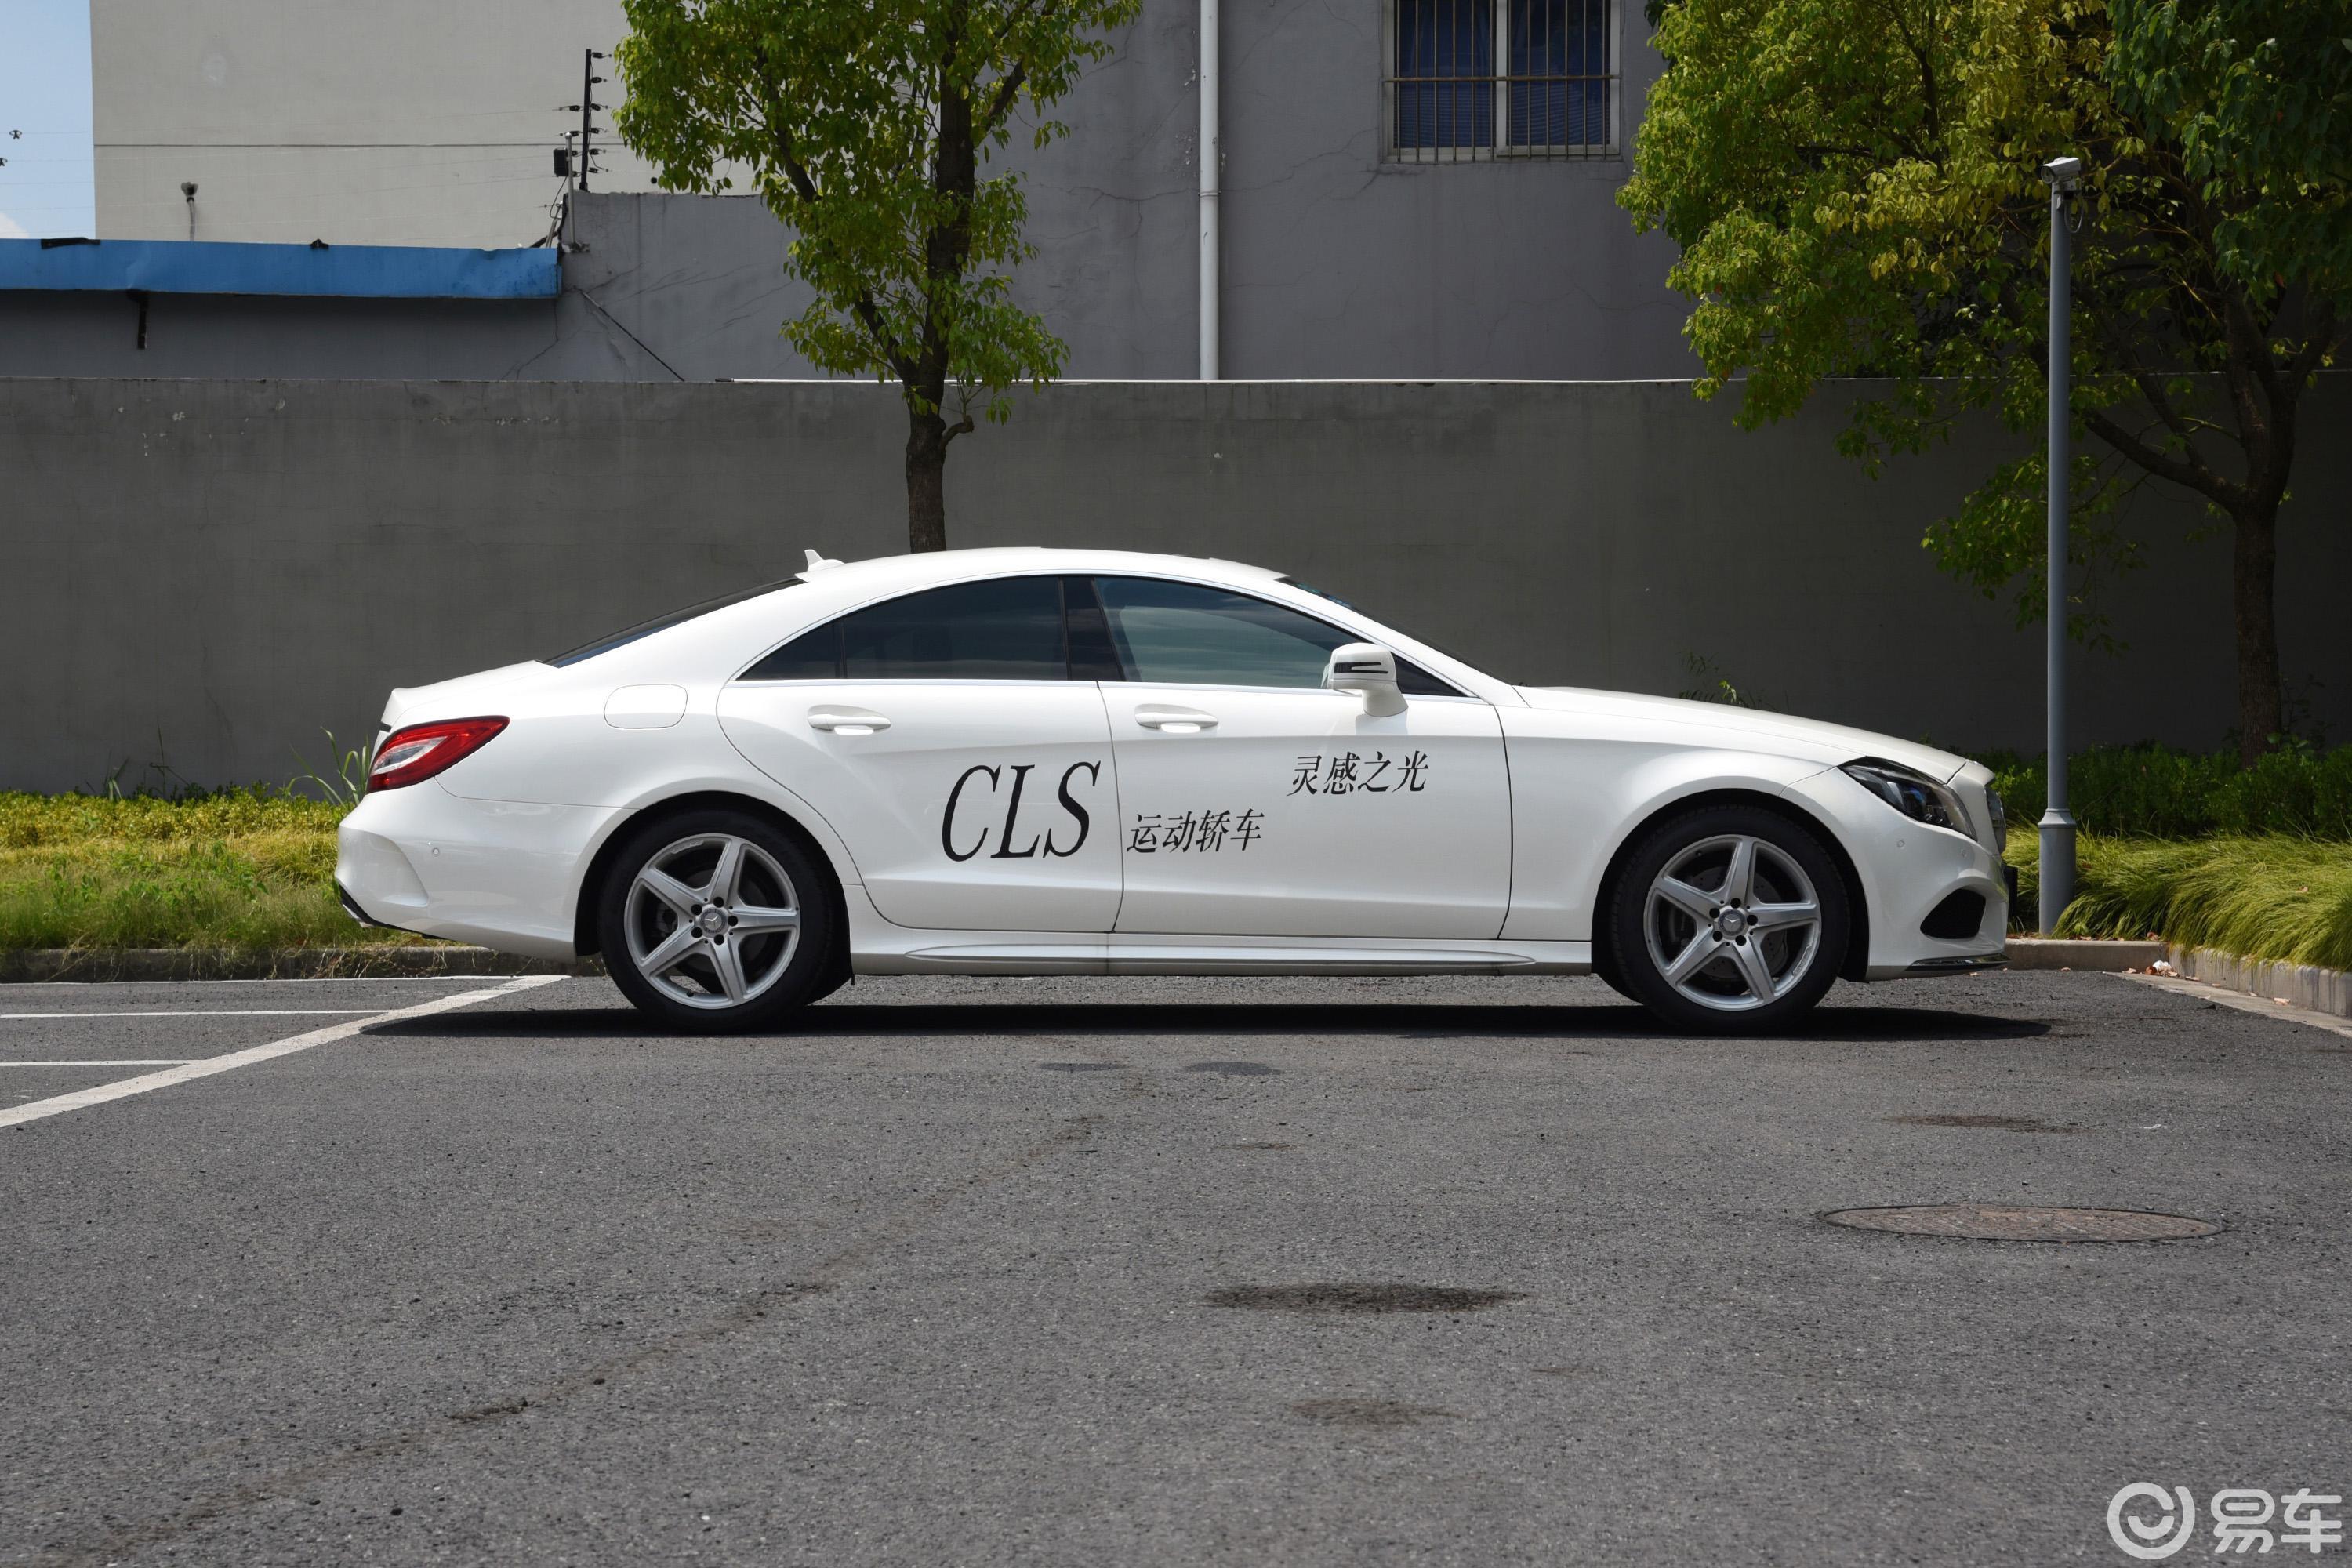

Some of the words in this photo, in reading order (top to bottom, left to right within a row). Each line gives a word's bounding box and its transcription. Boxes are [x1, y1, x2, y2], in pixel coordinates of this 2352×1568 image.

[1287, 750, 1429, 797] 灵感之光
[942, 760, 1101, 862] CLS
[1127, 808, 1265, 854] 运动轿车
